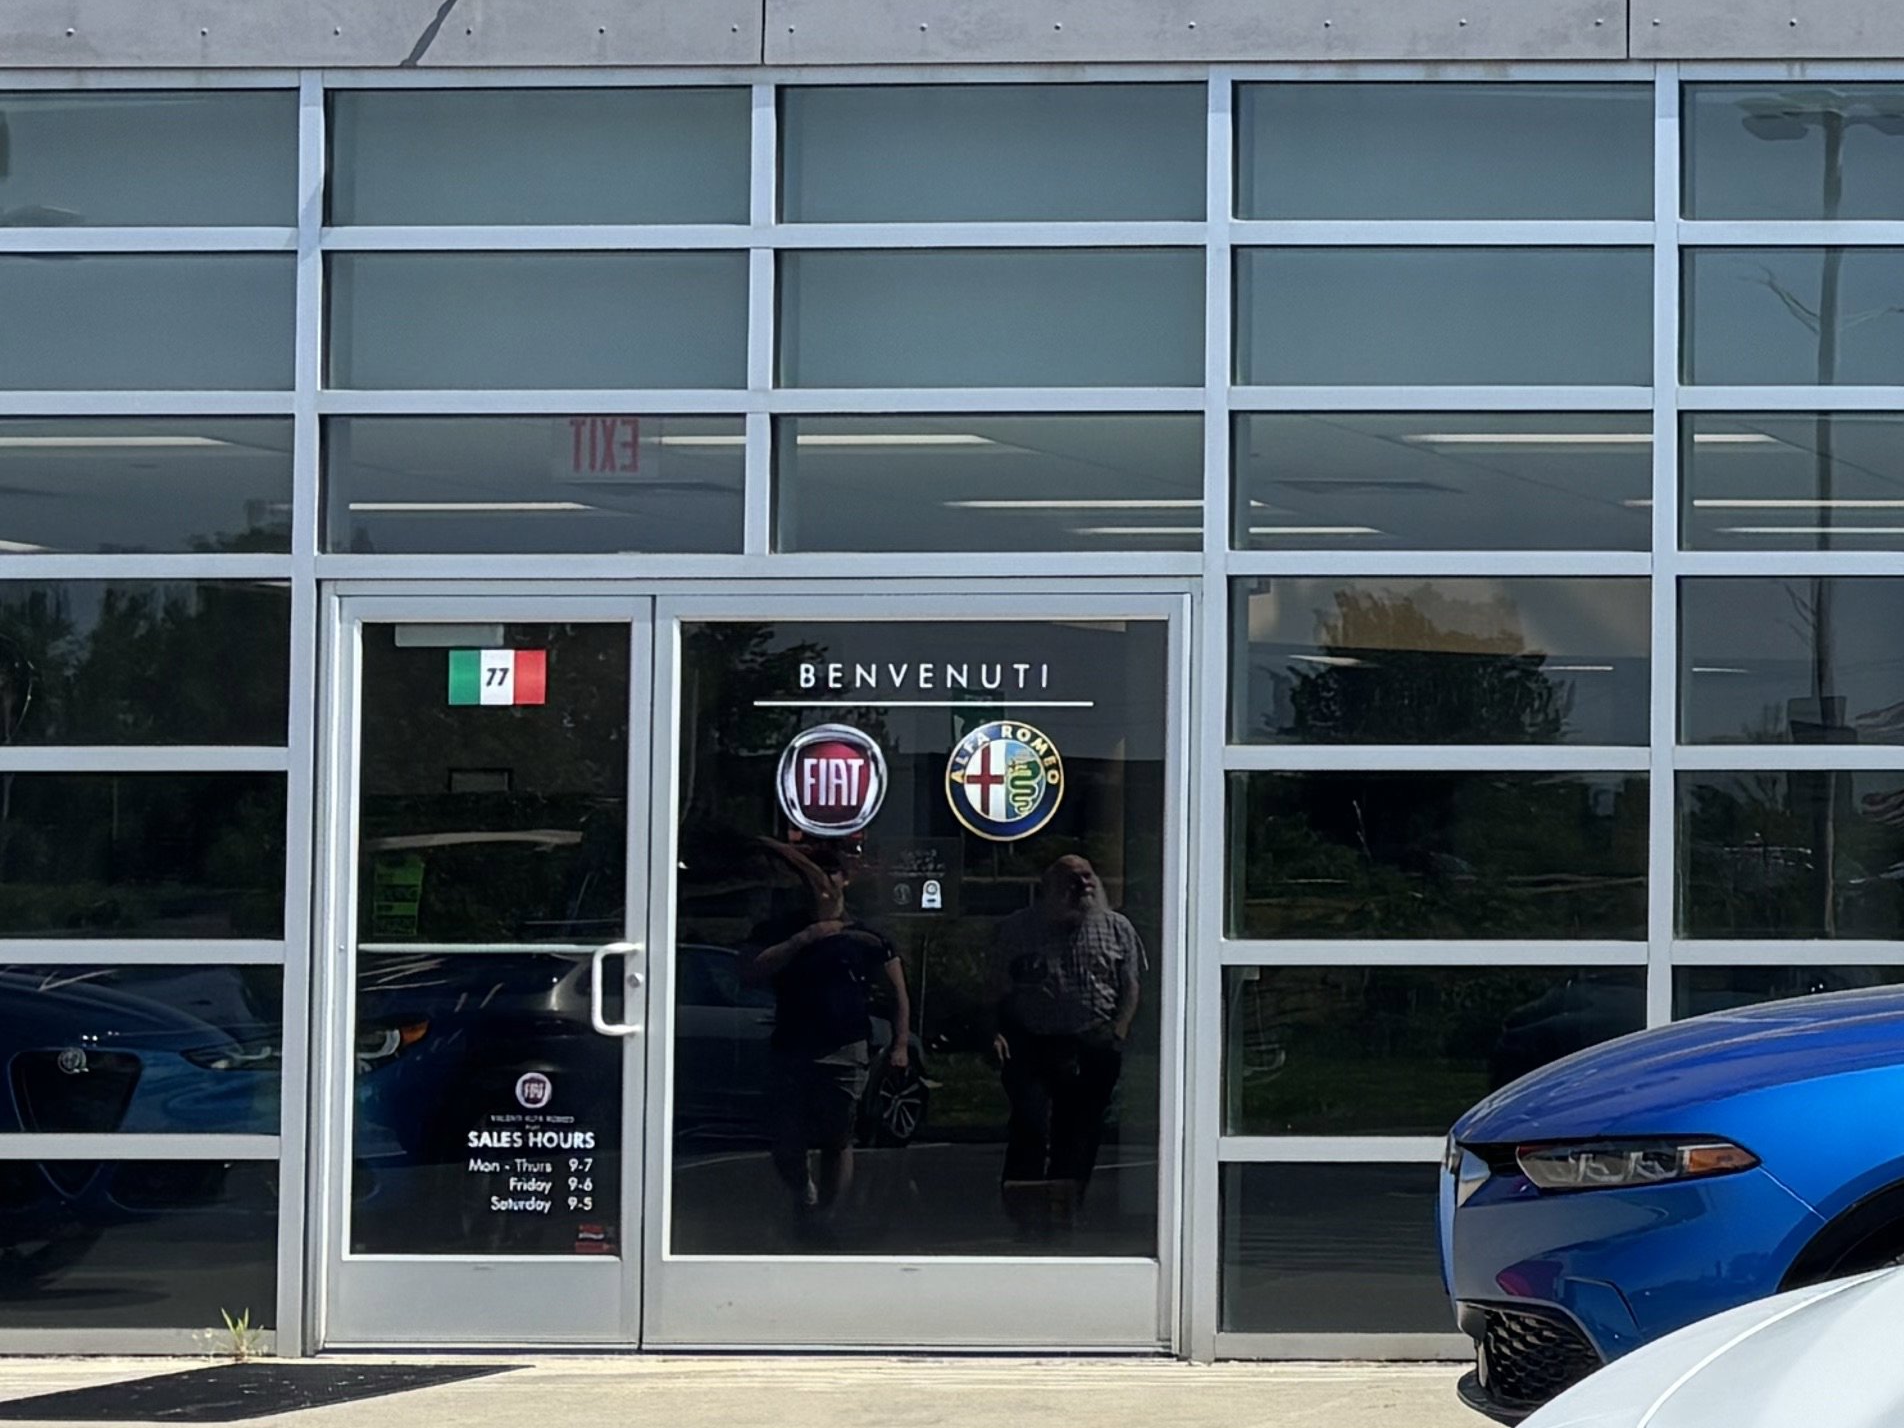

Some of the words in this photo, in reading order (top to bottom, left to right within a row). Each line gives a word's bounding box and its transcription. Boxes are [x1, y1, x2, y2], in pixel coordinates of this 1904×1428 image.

[486, 667, 510, 687] 77
[800, 663, 1048, 689] BENVENUTI
[949, 729, 990, 785] ALFA
[1000, 724, 1060, 786] ROMEO
[803, 758, 864, 806] FIAT
[468, 1131, 523, 1148] SALES
[528, 1131, 595, 1149] HOURS
[468, 1158, 500, 1172] Mon
[514, 1158, 552, 1172] Thurs
[568, 1158, 593, 1172] 9-7
[509, 1177, 552, 1195] Friday
[568, 1177, 593, 1192] 9-6
[491, 1196, 552, 1214] Saturday
[568, 1197, 593, 1211] 9-5
